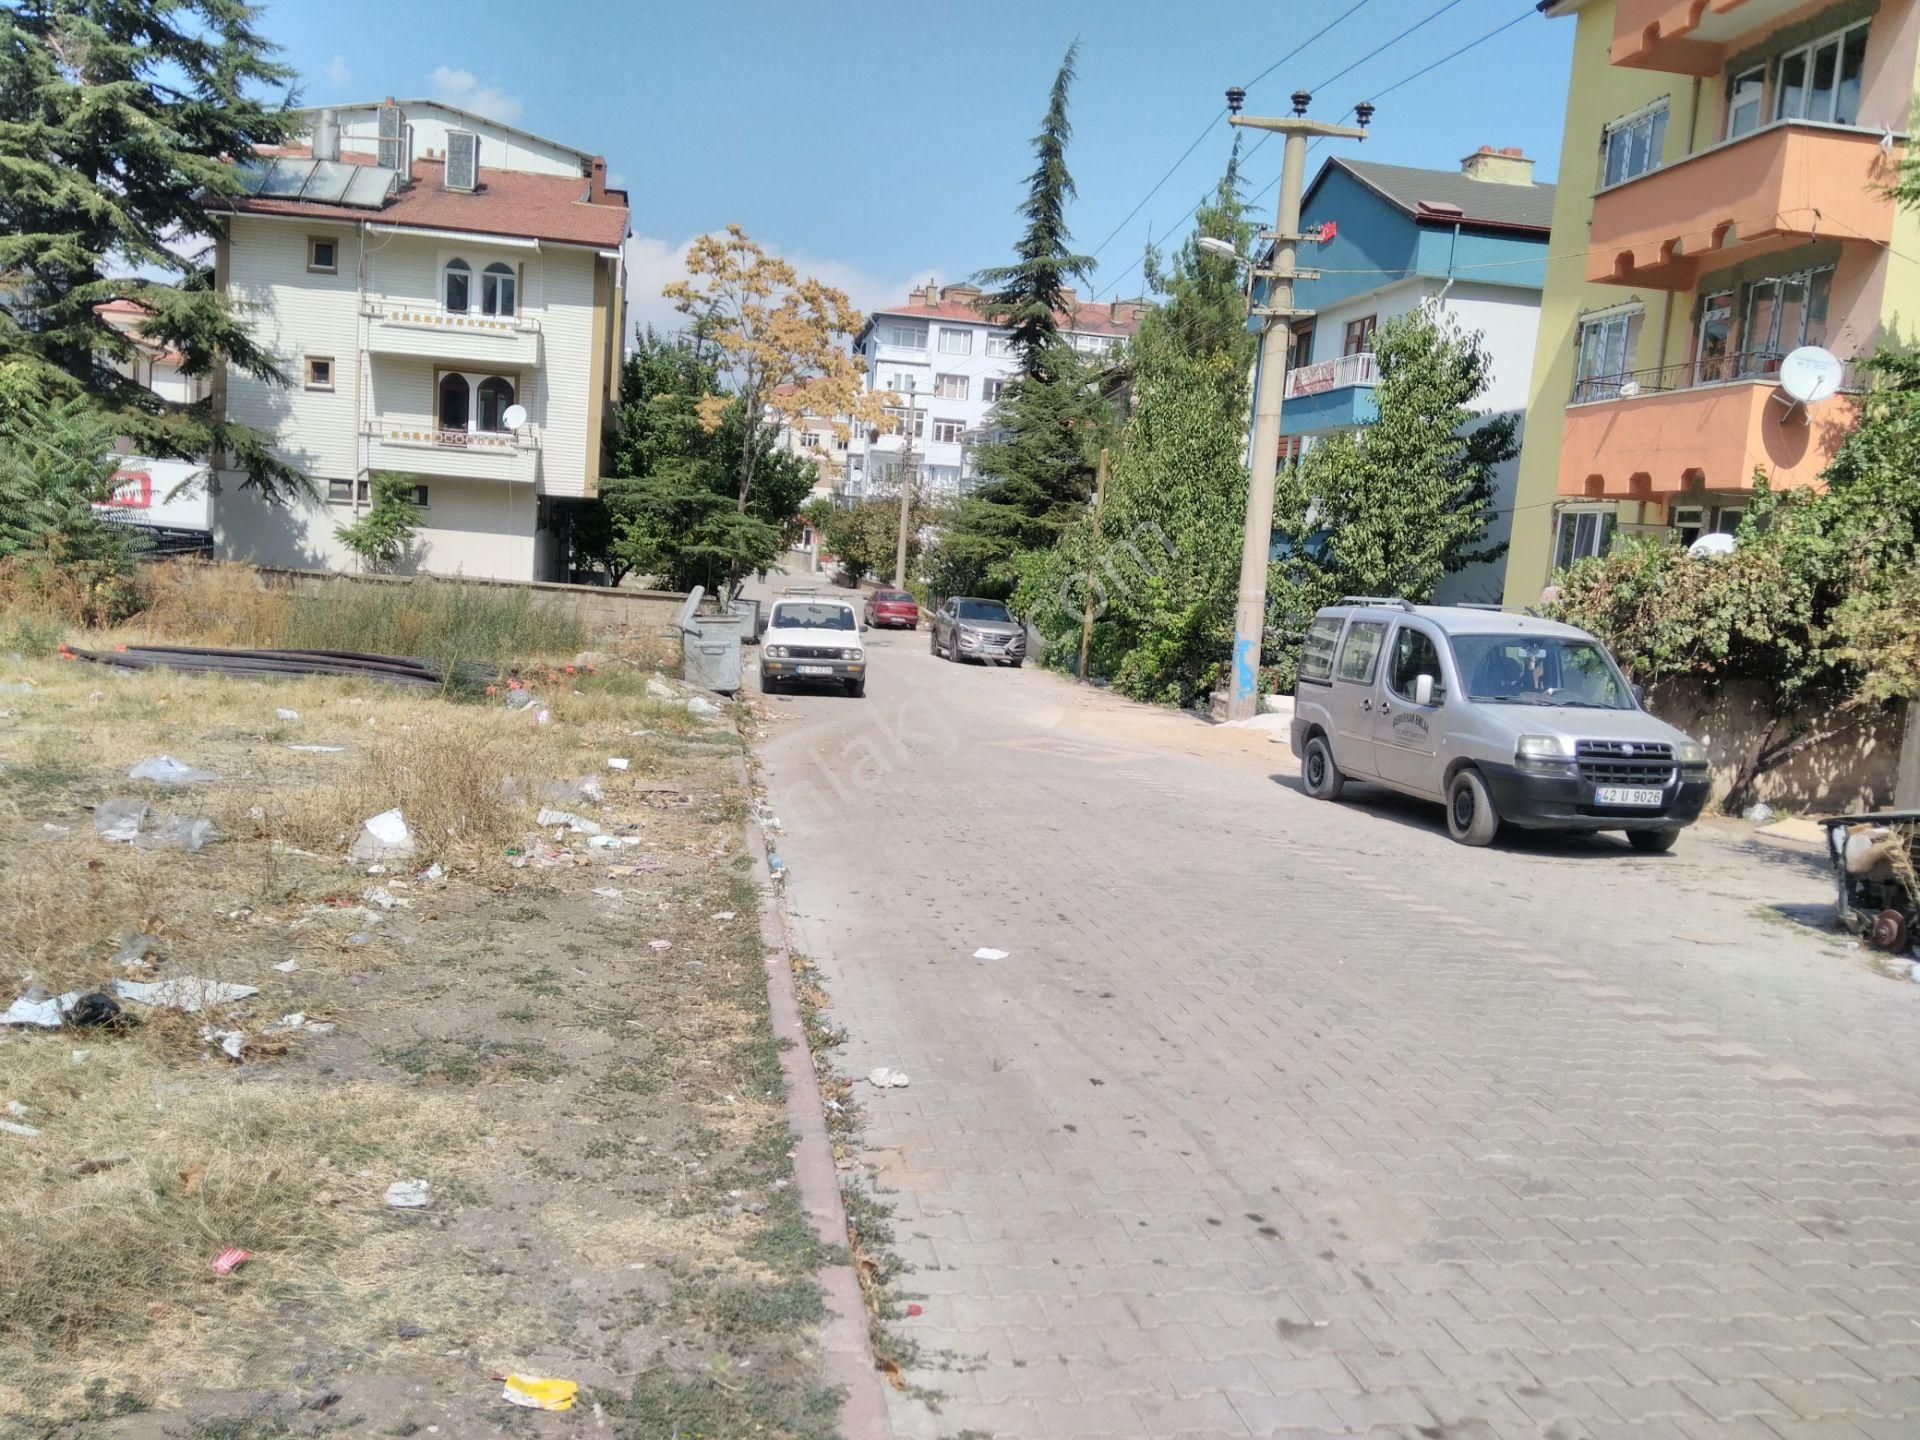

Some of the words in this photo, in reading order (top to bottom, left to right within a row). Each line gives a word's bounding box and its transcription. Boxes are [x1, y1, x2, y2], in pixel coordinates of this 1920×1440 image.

[1602, 789, 1617, 801] 42
[1621, 790, 1629, 802] U
[1633, 791, 1661, 803] 9026
